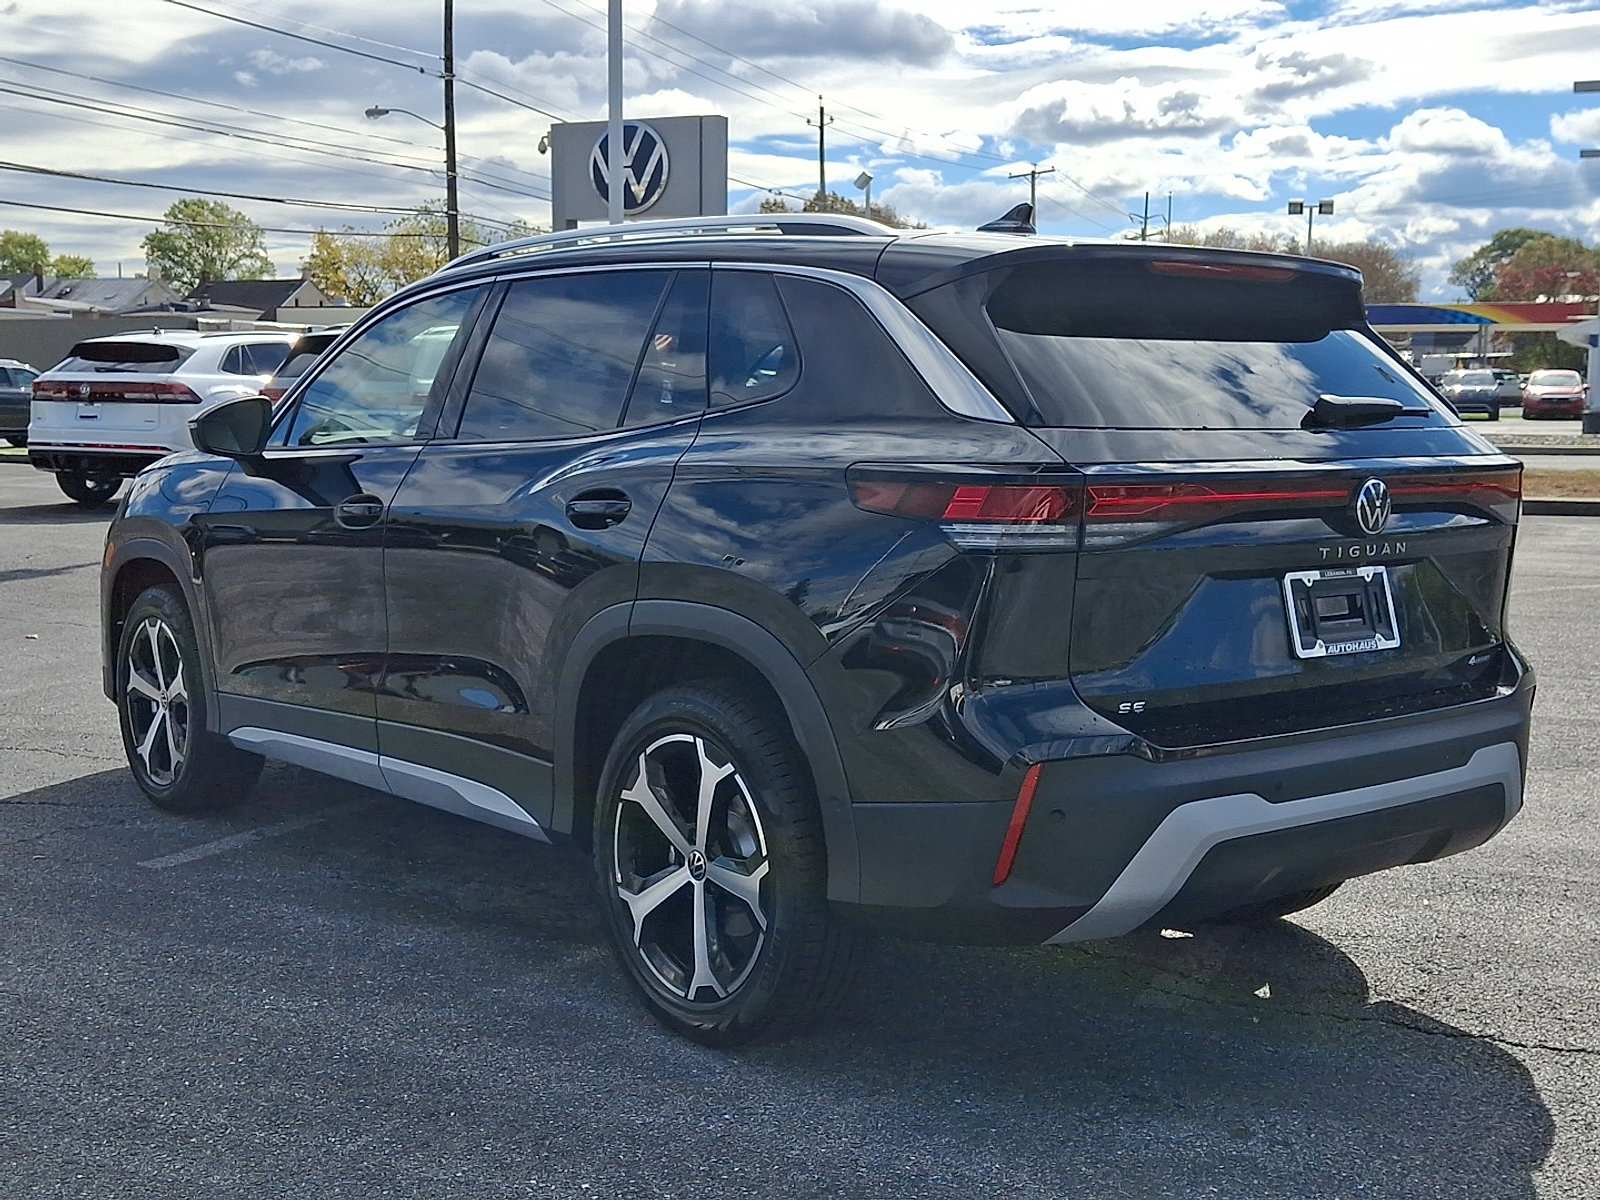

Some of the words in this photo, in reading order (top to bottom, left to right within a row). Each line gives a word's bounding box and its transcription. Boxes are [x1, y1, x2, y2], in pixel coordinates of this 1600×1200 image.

[1319, 542, 1406, 560] TIGUAN
[1327, 640, 1377, 654] AUTOHAUS
[1118, 701, 1146, 714] SE
